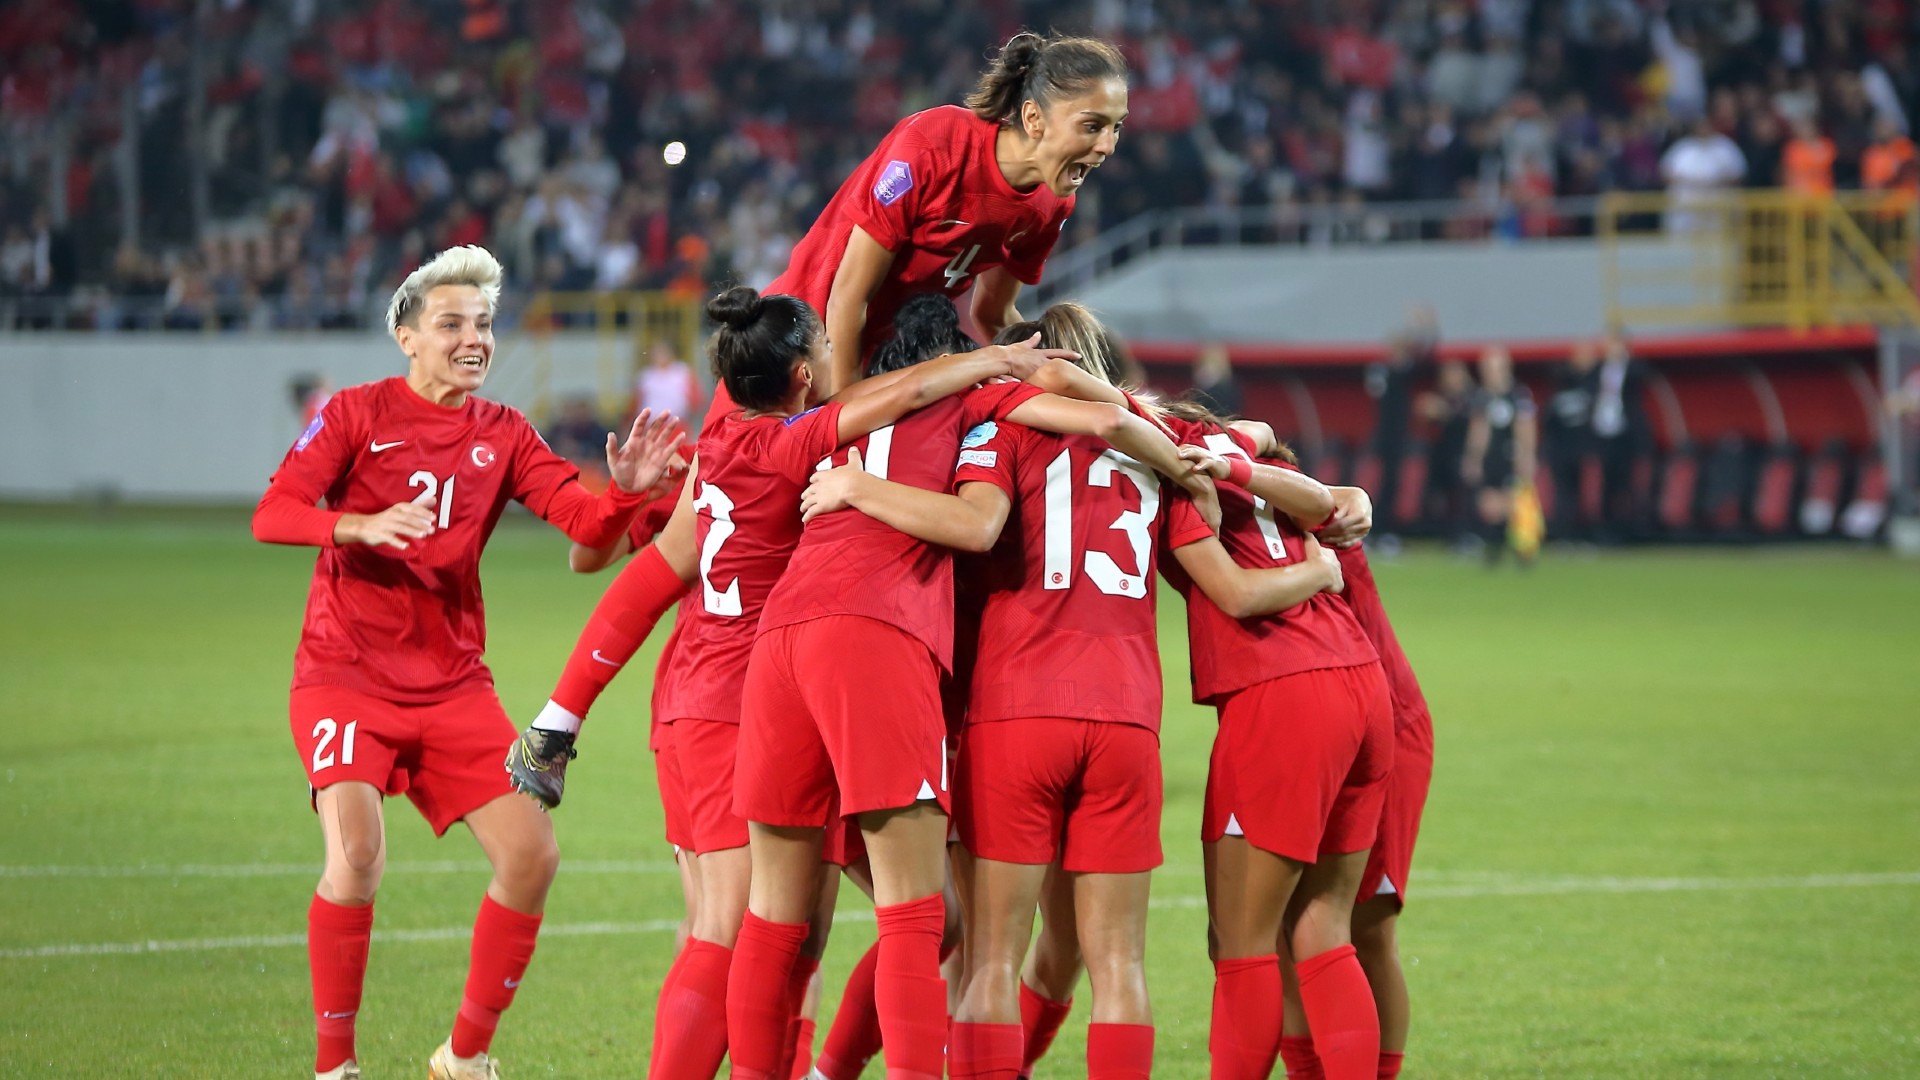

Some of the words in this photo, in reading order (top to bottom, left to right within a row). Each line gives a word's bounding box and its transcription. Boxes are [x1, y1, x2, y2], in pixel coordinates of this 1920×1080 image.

[944, 244, 981, 288] 4
[408, 470, 456, 529] 21
[1044, 447, 1160, 600] 13
[693, 480, 743, 616] 2
[312, 717, 357, 774] 21
